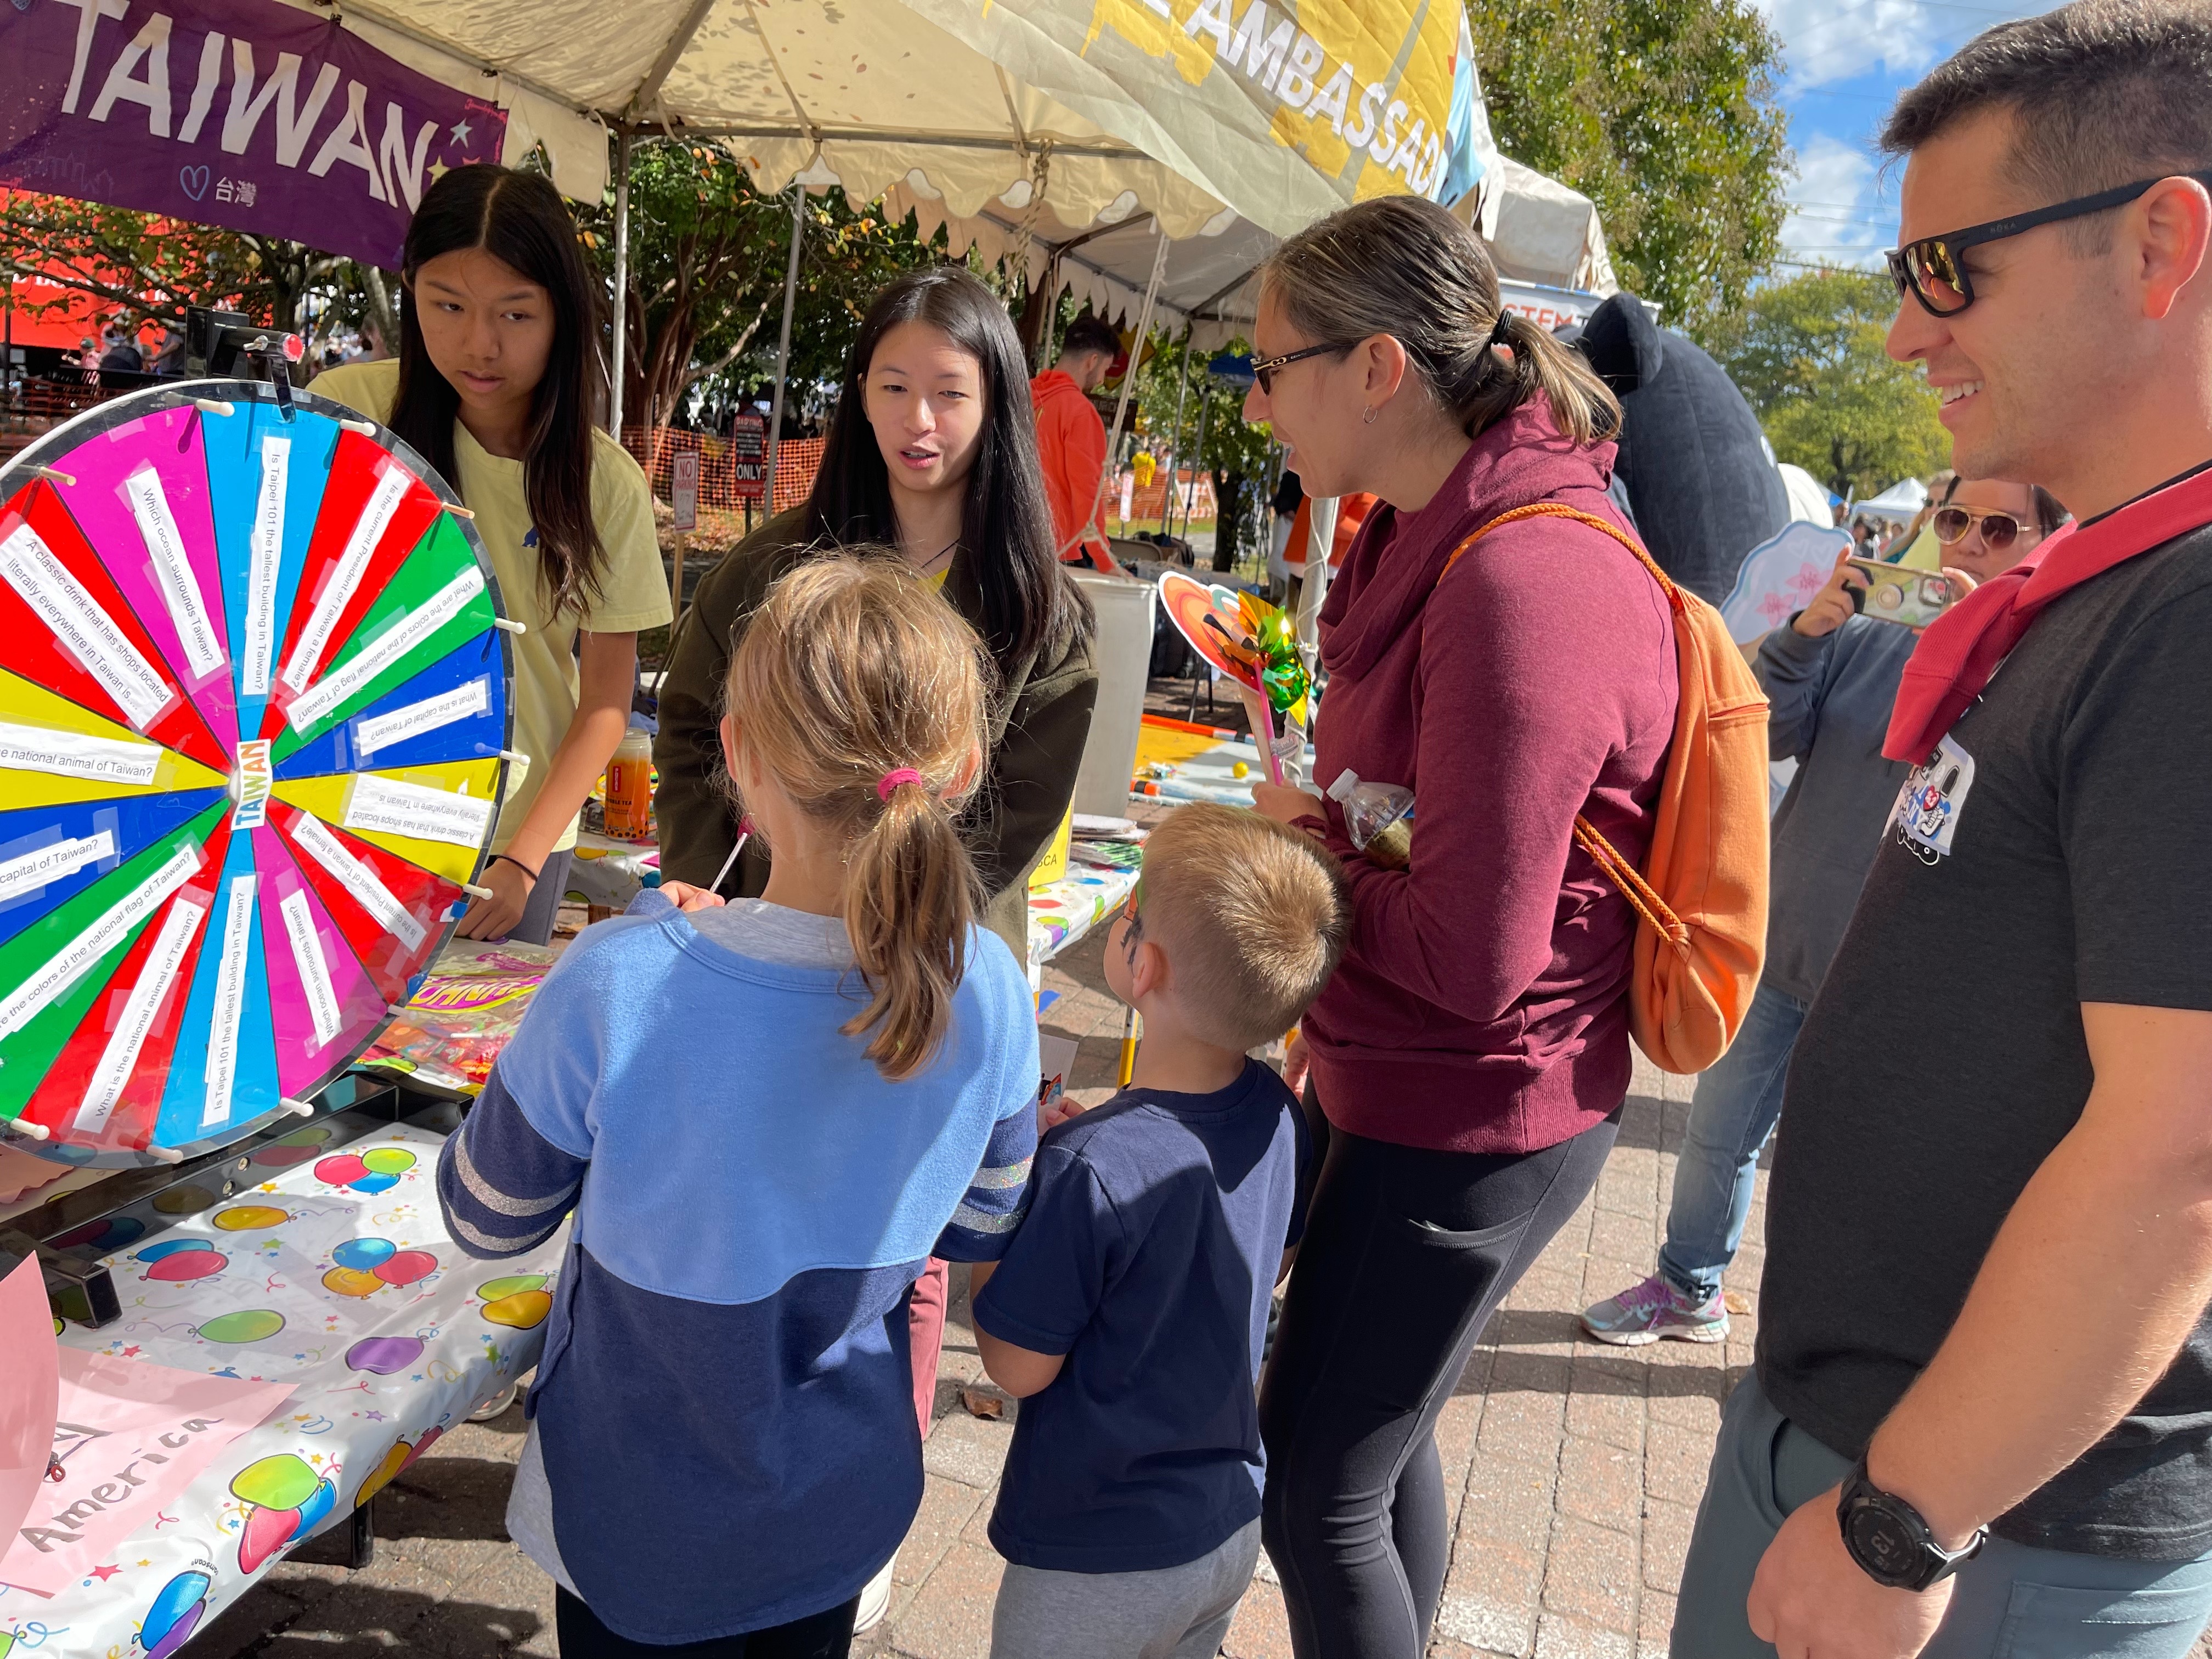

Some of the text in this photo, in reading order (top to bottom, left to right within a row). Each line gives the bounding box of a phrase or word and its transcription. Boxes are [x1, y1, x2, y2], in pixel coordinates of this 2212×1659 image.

[53, 0, 439, 215] TAIWAN
[1183, 0, 1440, 194] AMBASSAD
[215, 177, 256, 207] 台灣
[679, 461, 692, 478] NO
[736, 463, 762, 481] ONLY
[7, 558, 41, 596] literally
[39, 596, 87, 648] everywhere
[84, 645, 96, 659] in
[95, 655, 123, 690] Taiwan
[26, 539, 168, 702] A classic drink that has shops located
[144, 488, 213, 661] Which ocean surrounds Taiwan?
[255, 454, 281, 689] Is Taipei 101 the tallest building in Taiwan?
[292, 484, 399, 687] Is the current President of Taiwan a female?
[298, 581, 475, 723] What are the colors of the national flag of Taiwan?
[11, 751, 57, 764] national
[58, 757, 95, 769] animal
[96, 760, 109, 771] of
[111, 761, 153, 777] Taiwan?
[371, 692, 477, 741] What is the capital of Taiwan?
[235, 742, 268, 826] TAIWAN
[352, 811, 476, 841] A classic drink that has shops located
[387, 797, 411, 809] Taiwan
[413, 801, 420, 811] in
[421, 803, 458, 816] everywhere
[458, 809, 480, 822] literally
[0, 839, 98, 883] capital of Taiwan?
[301, 825, 417, 939] Is the current President of Taiwan a female?
[9, 852, 190, 1017] the colors of the national flag of Taiwan?
[289, 906, 334, 1037] Which ocean surrounds Taiwan?
[95, 911, 195, 1116] What is the national animal of Taiwan?
[213, 893, 244, 1110] Is Taipei 101 the tallest building in Taiwan?
[20, 1418, 225, 1553] America
